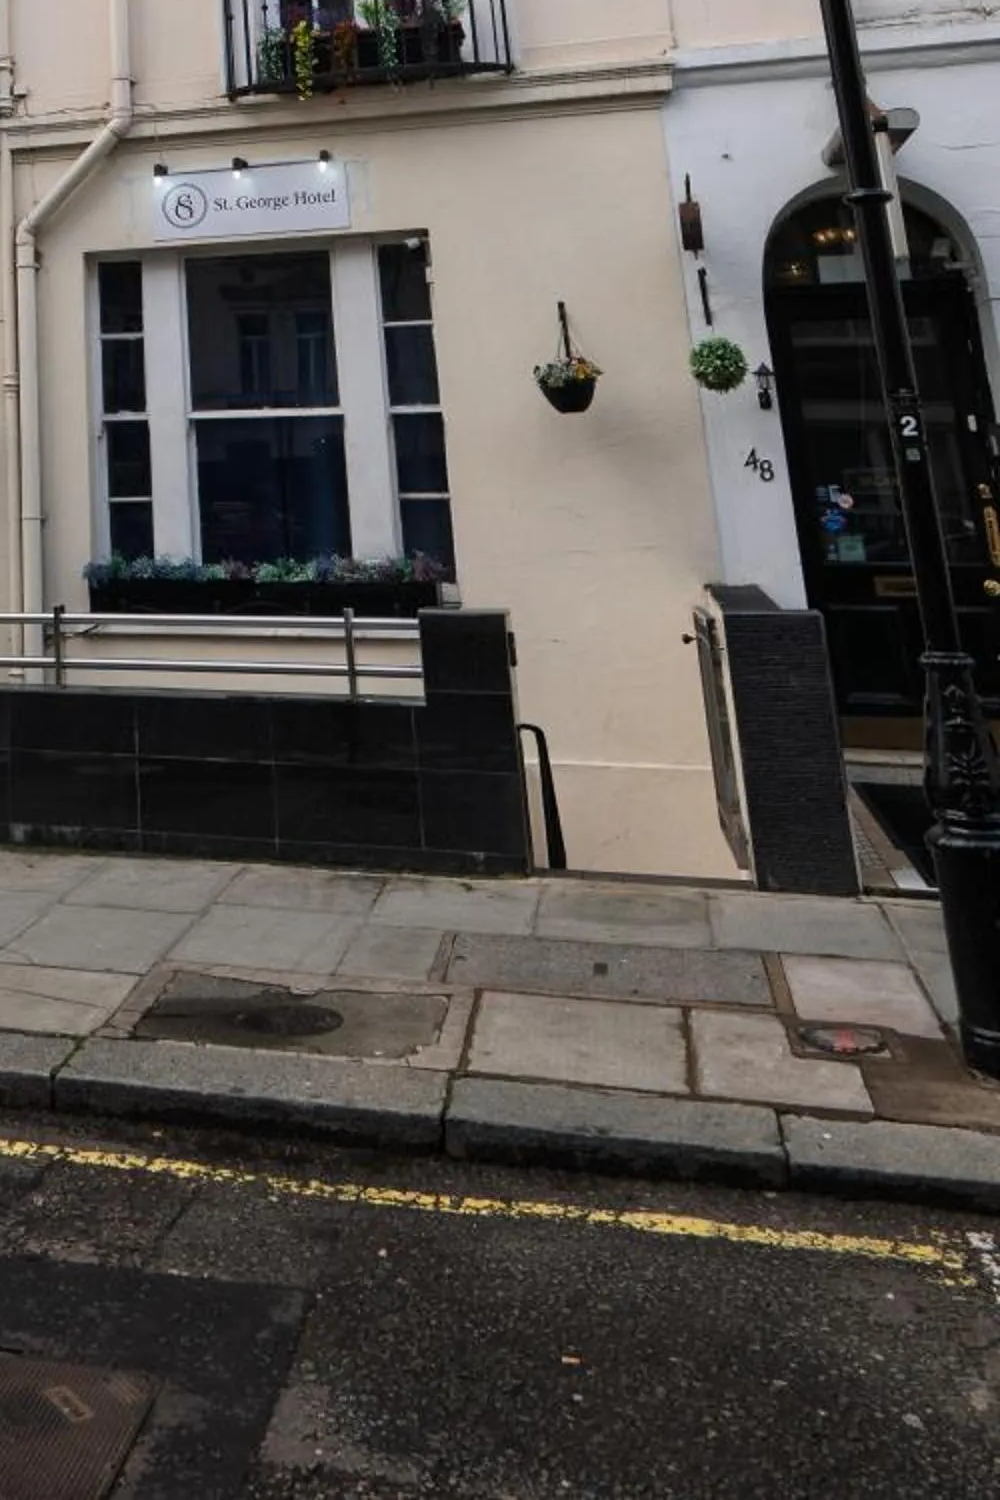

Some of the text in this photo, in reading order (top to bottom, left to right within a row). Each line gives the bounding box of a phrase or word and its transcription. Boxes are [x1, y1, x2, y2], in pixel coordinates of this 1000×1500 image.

[212, 188, 335, 211] St. George Hotel
[900, 415, 919, 437] 2
[743, 447, 774, 482] 48
